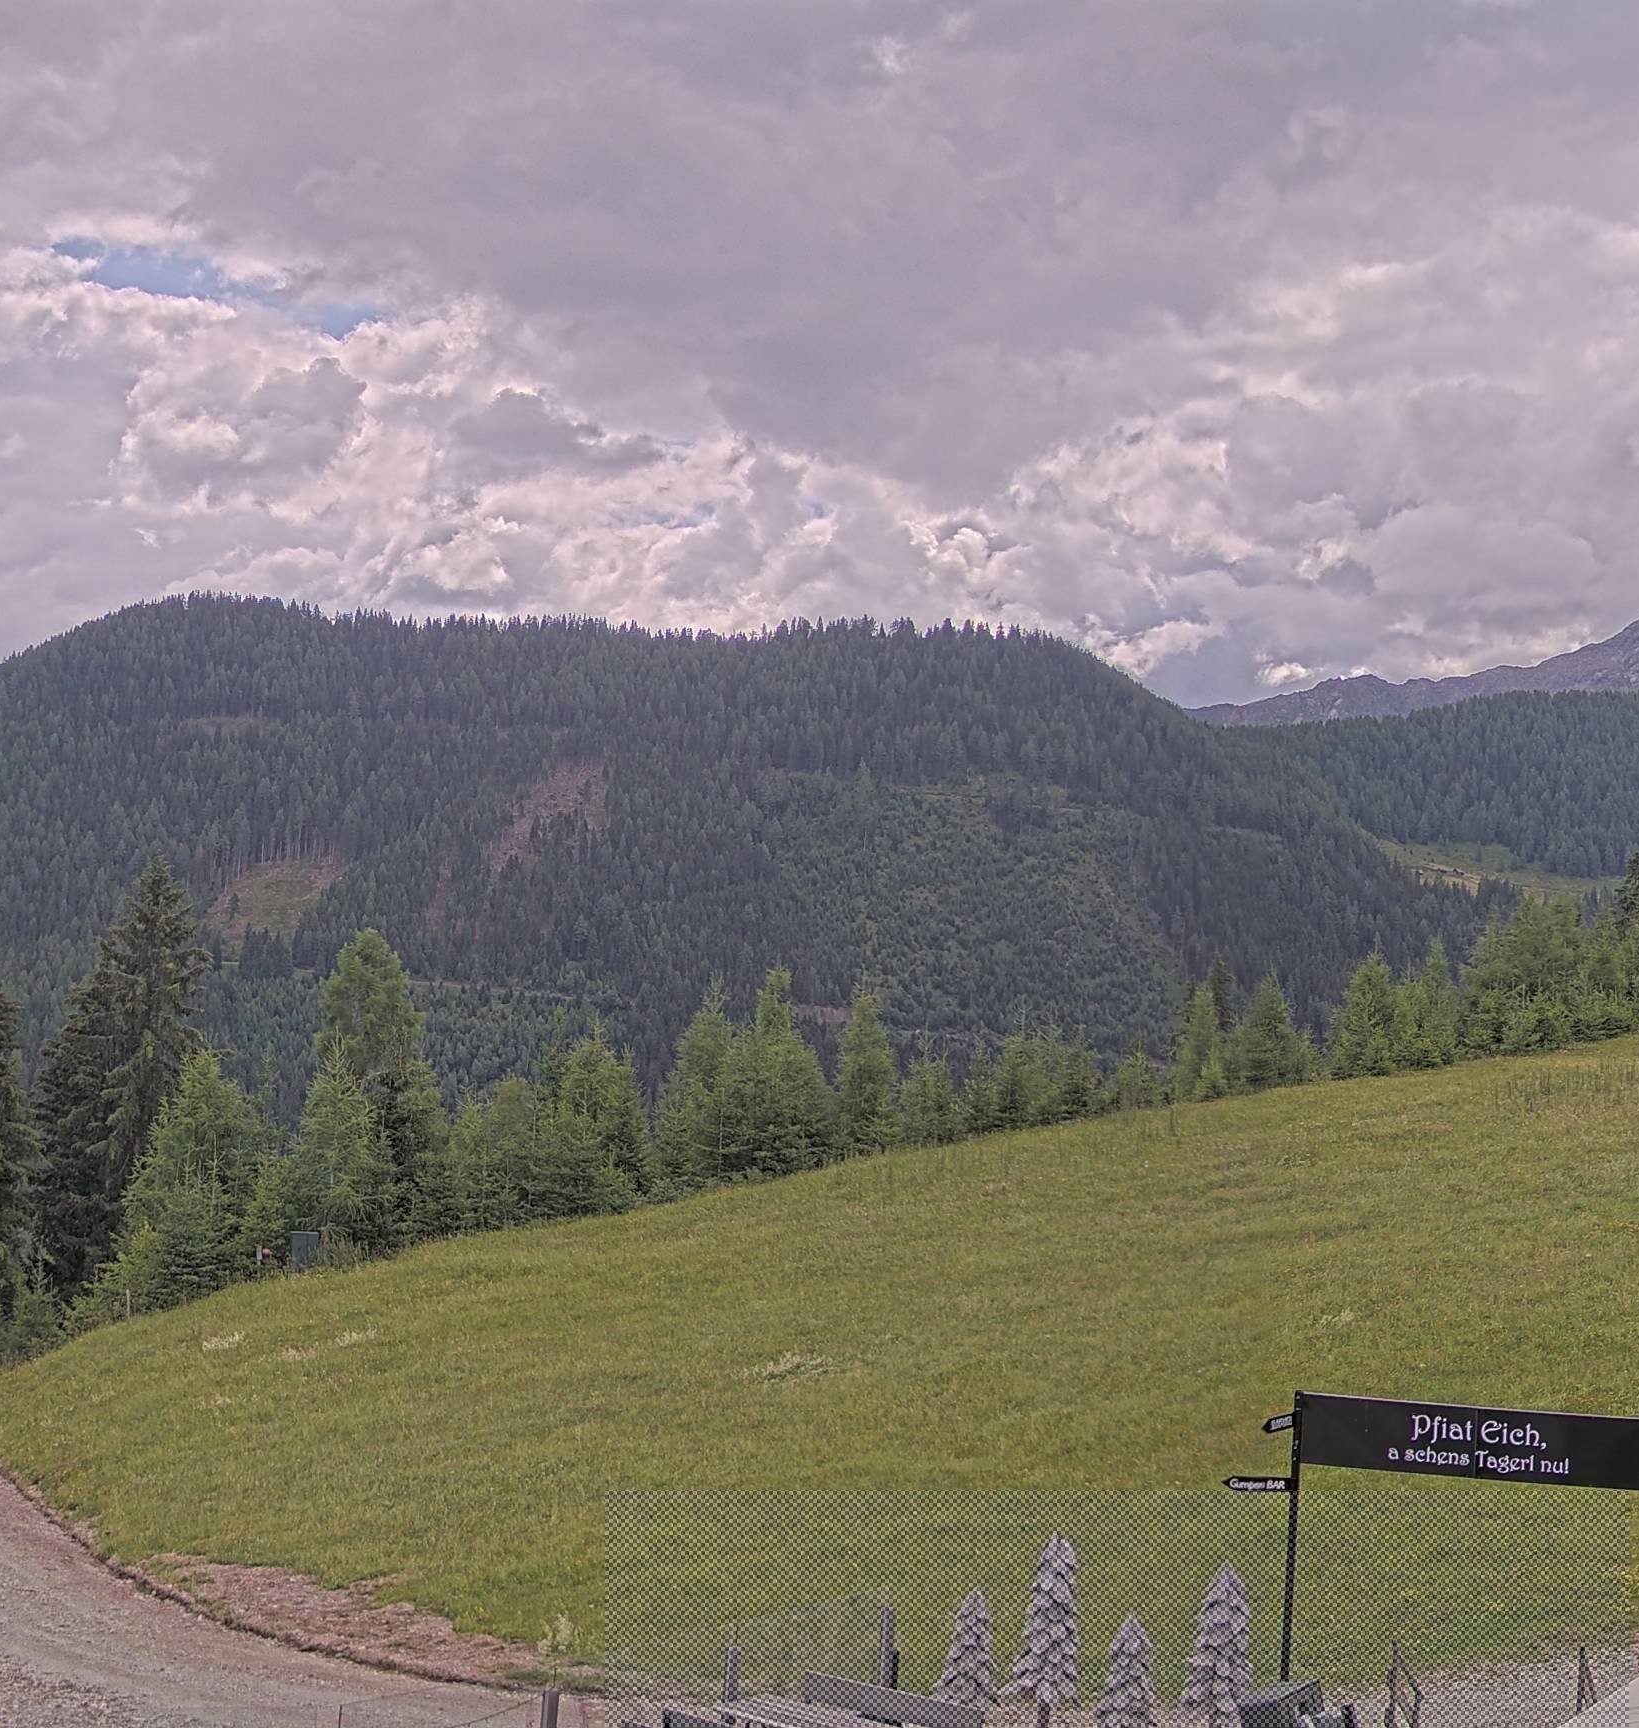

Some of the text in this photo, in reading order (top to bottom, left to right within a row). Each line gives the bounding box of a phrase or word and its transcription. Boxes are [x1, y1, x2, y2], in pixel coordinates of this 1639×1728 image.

[1411, 1414, 1548, 1450] Pfiat Eich,
[1387, 1446, 1571, 1475] a schens Tagerl nu!
[1266, 1479, 1286, 1490] BAR
